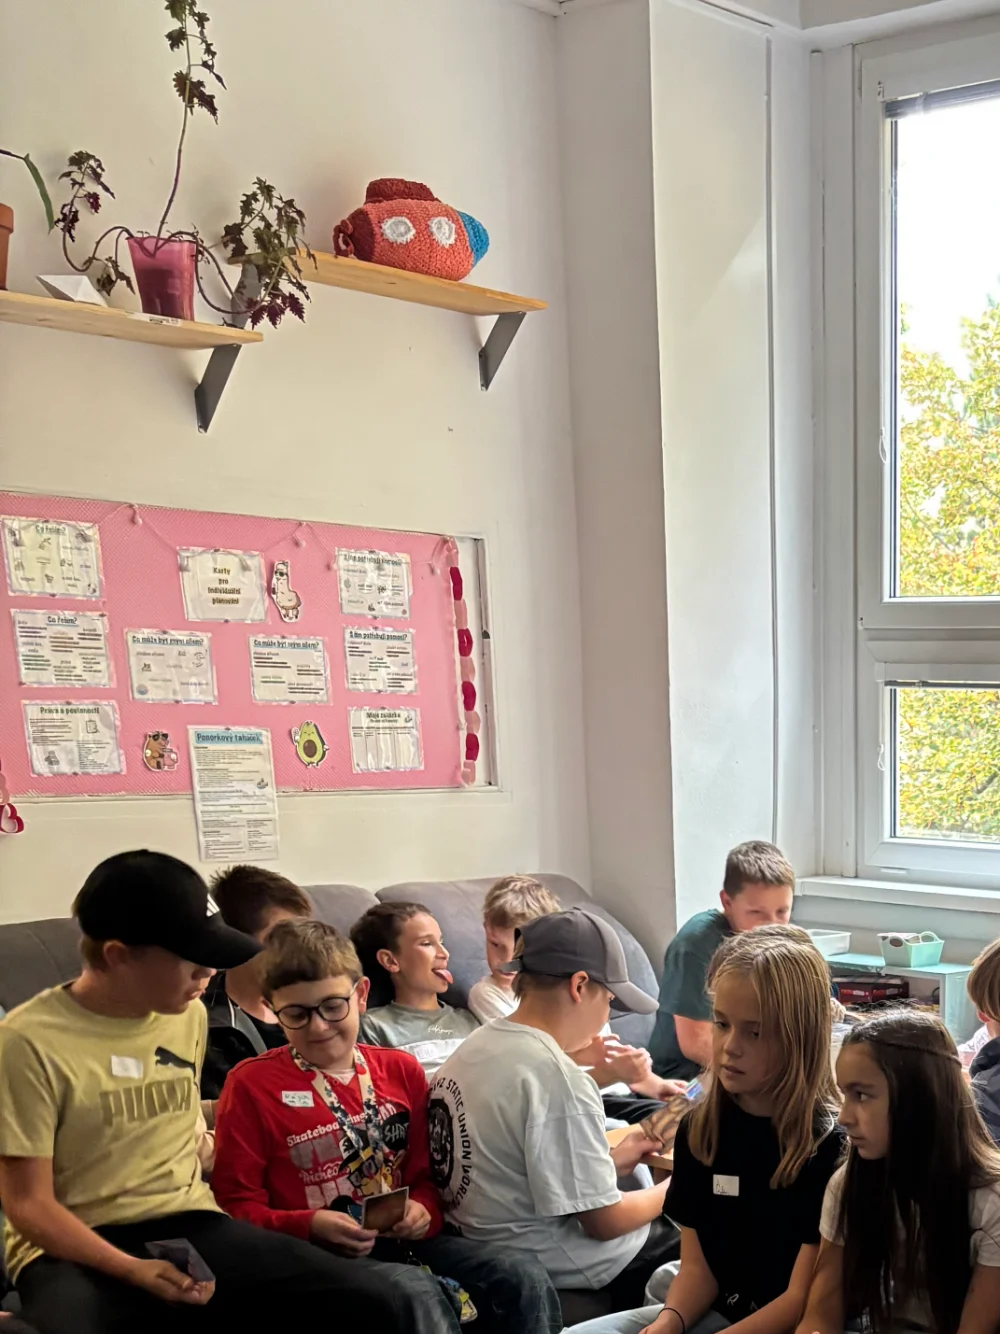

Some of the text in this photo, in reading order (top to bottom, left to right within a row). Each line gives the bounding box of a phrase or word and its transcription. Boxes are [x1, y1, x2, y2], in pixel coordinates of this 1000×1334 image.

[287, 1112, 367, 1147] Skateboaing
[446, 1079, 464, 1112] STATIC
[458, 1112, 472, 1160] UNION
